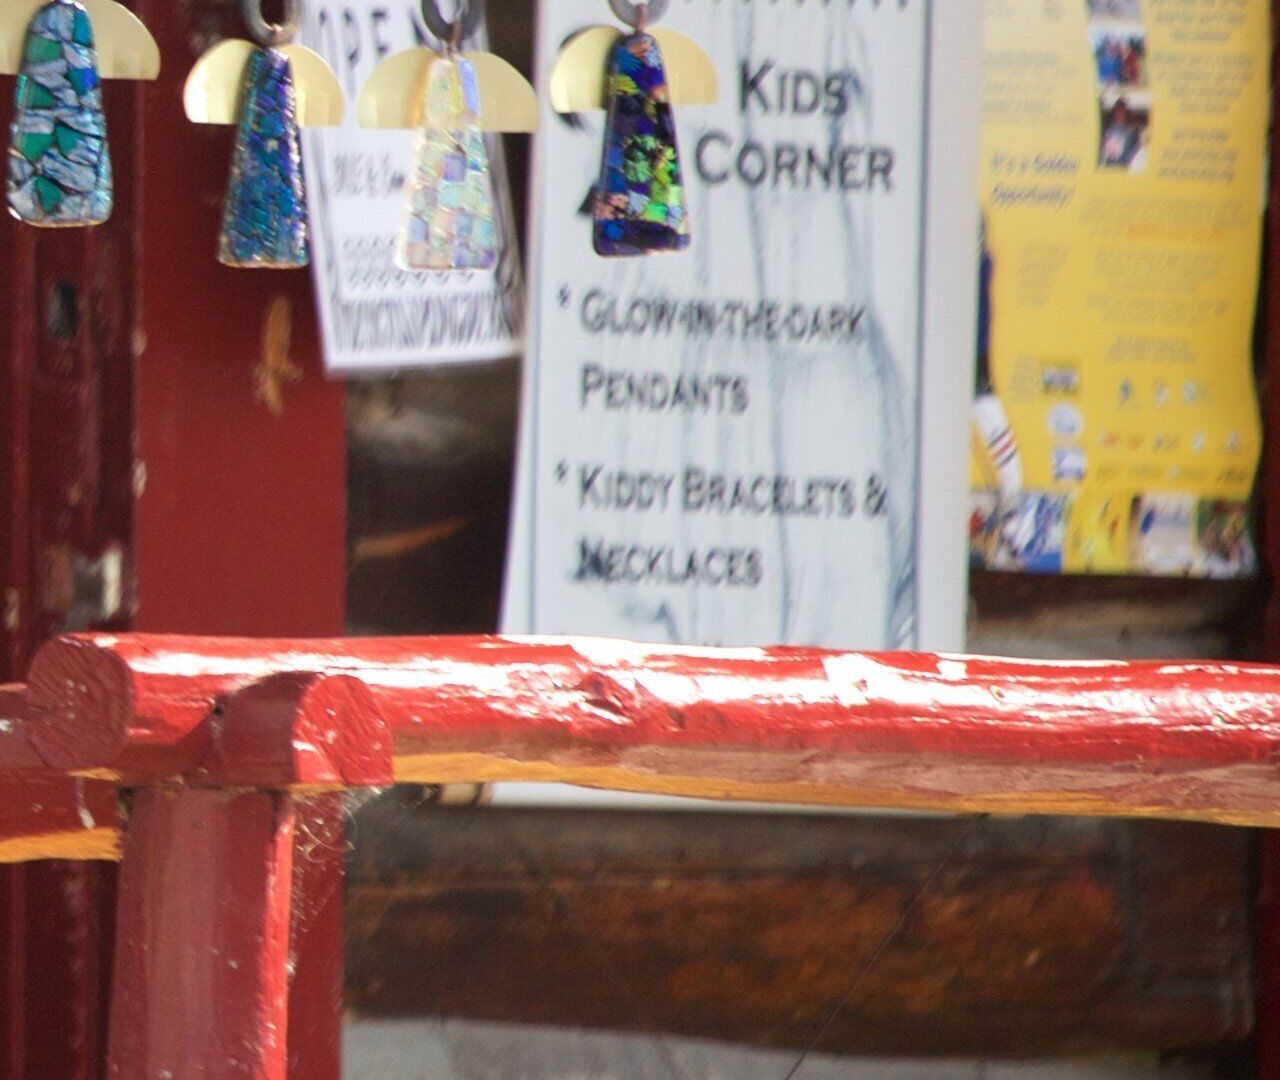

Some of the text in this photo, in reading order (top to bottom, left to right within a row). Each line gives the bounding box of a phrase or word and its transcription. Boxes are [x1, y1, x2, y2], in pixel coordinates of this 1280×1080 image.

[696, 130, 896, 191] CORNER
[580, 362, 750, 414] PENDANTS
[579, 463, 888, 519] KIDDY BRACELETS &
[576, 536, 762, 587] NECKLACES
